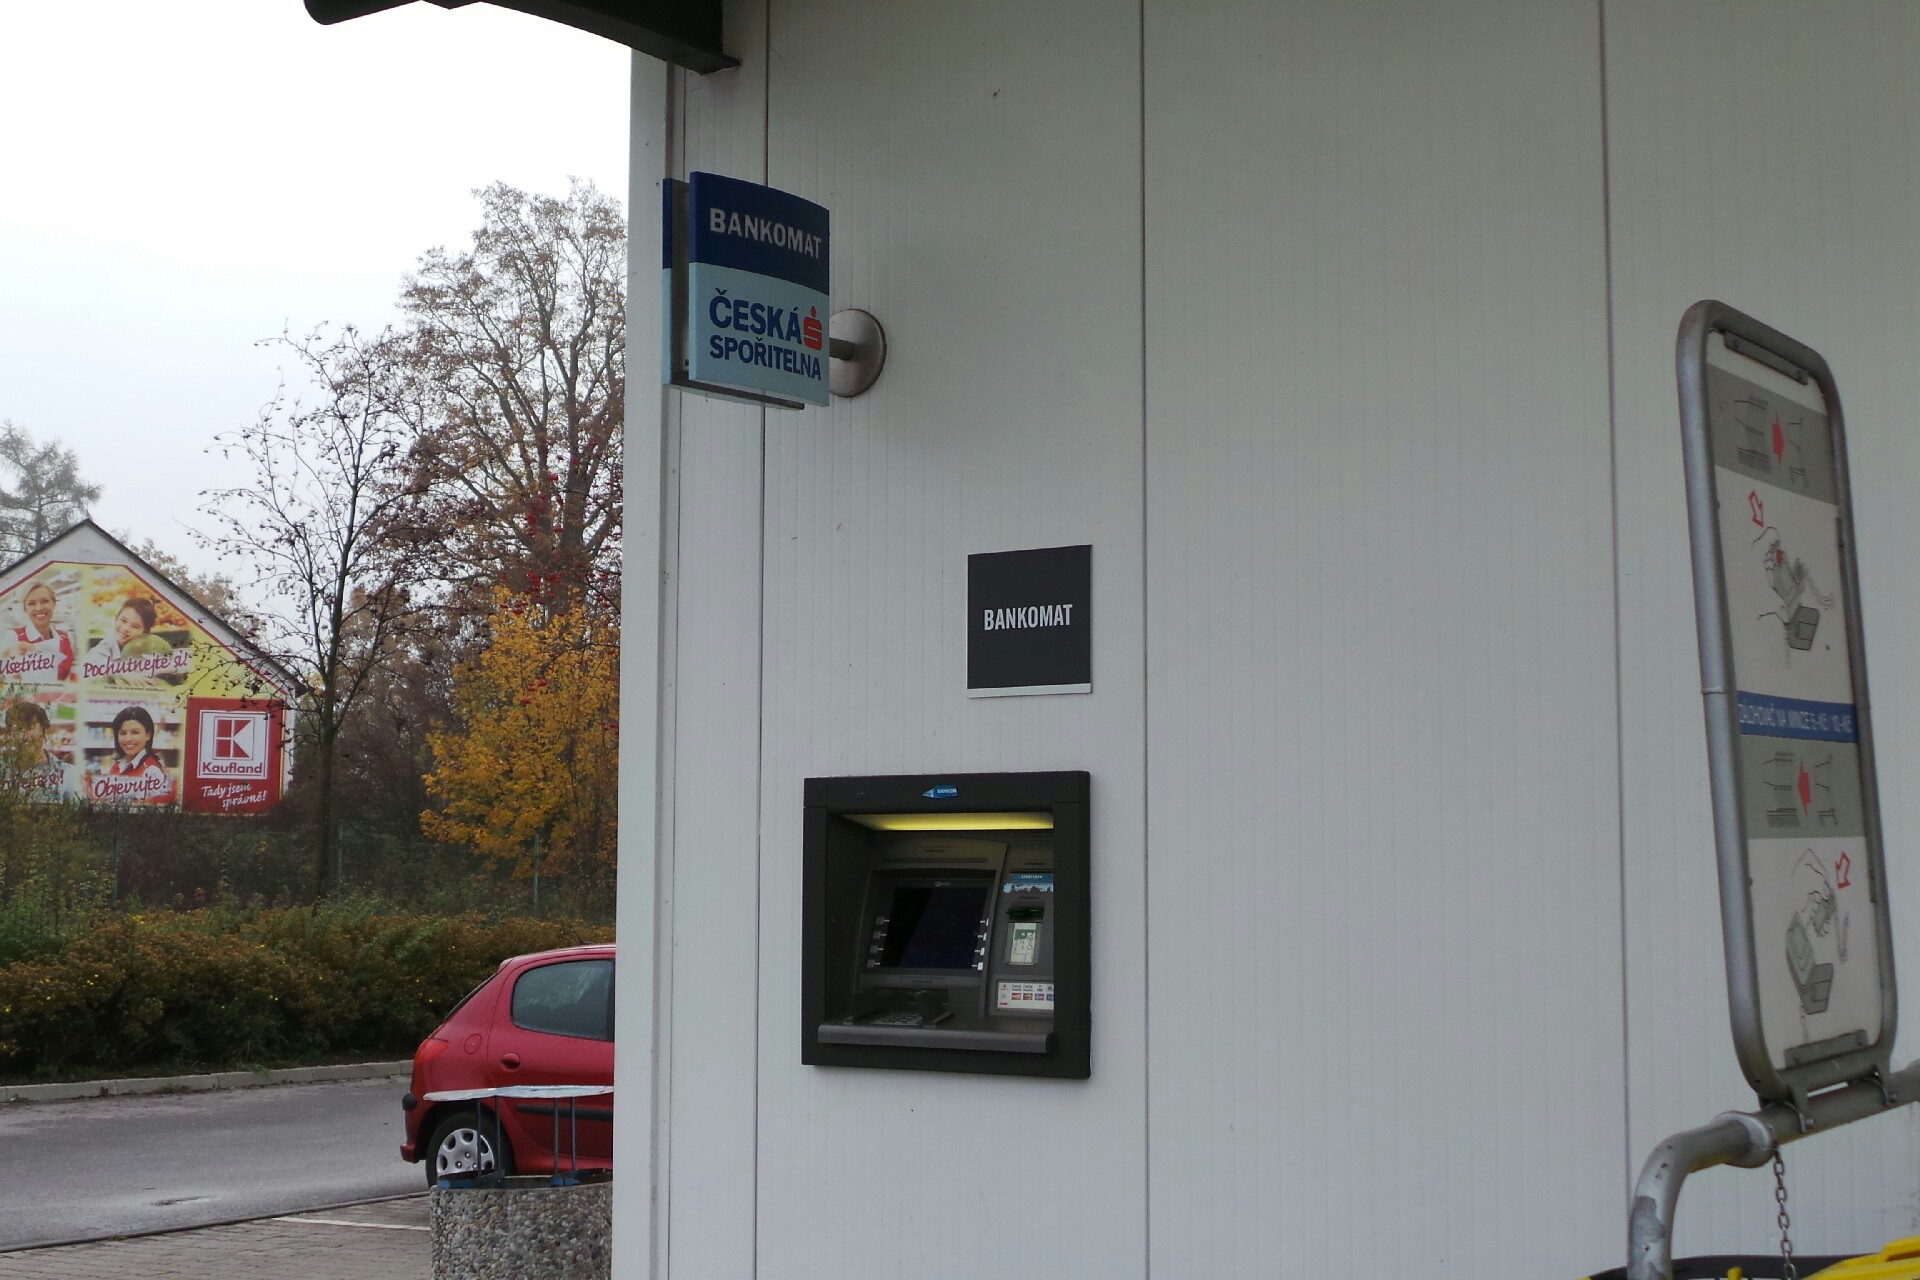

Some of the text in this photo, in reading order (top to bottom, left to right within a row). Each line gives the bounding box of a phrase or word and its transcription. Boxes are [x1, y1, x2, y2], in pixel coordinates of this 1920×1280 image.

[709, 207, 822, 259] BANKOMAT
[709, 287, 802, 345] ČESKÁ
[709, 335, 821, 381] SPOŘITELNA
[984, 603, 1073, 631] BANKOMAT
[83, 652, 170, 679] Pochutnejte
[202, 761, 263, 774] Kaufland
[94, 773, 167, 802] Objevujte!
[201, 784, 227, 799] Tady
